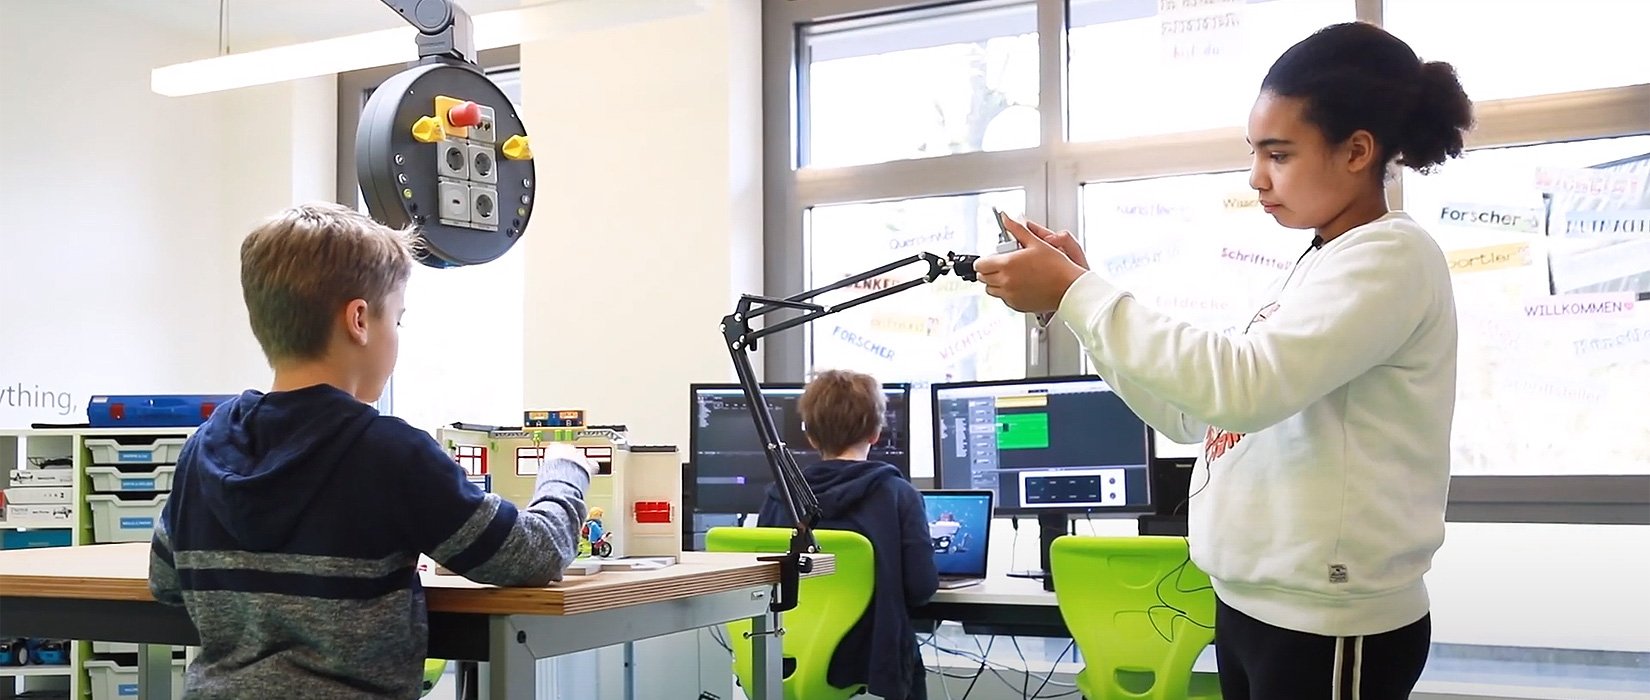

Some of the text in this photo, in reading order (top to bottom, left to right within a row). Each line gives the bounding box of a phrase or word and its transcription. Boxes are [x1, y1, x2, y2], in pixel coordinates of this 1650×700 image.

[1440, 206, 1521, 226] Forscher
[1524, 300, 1623, 317] WILLKOMMEN
[831, 325, 896, 362] FORSCHER
